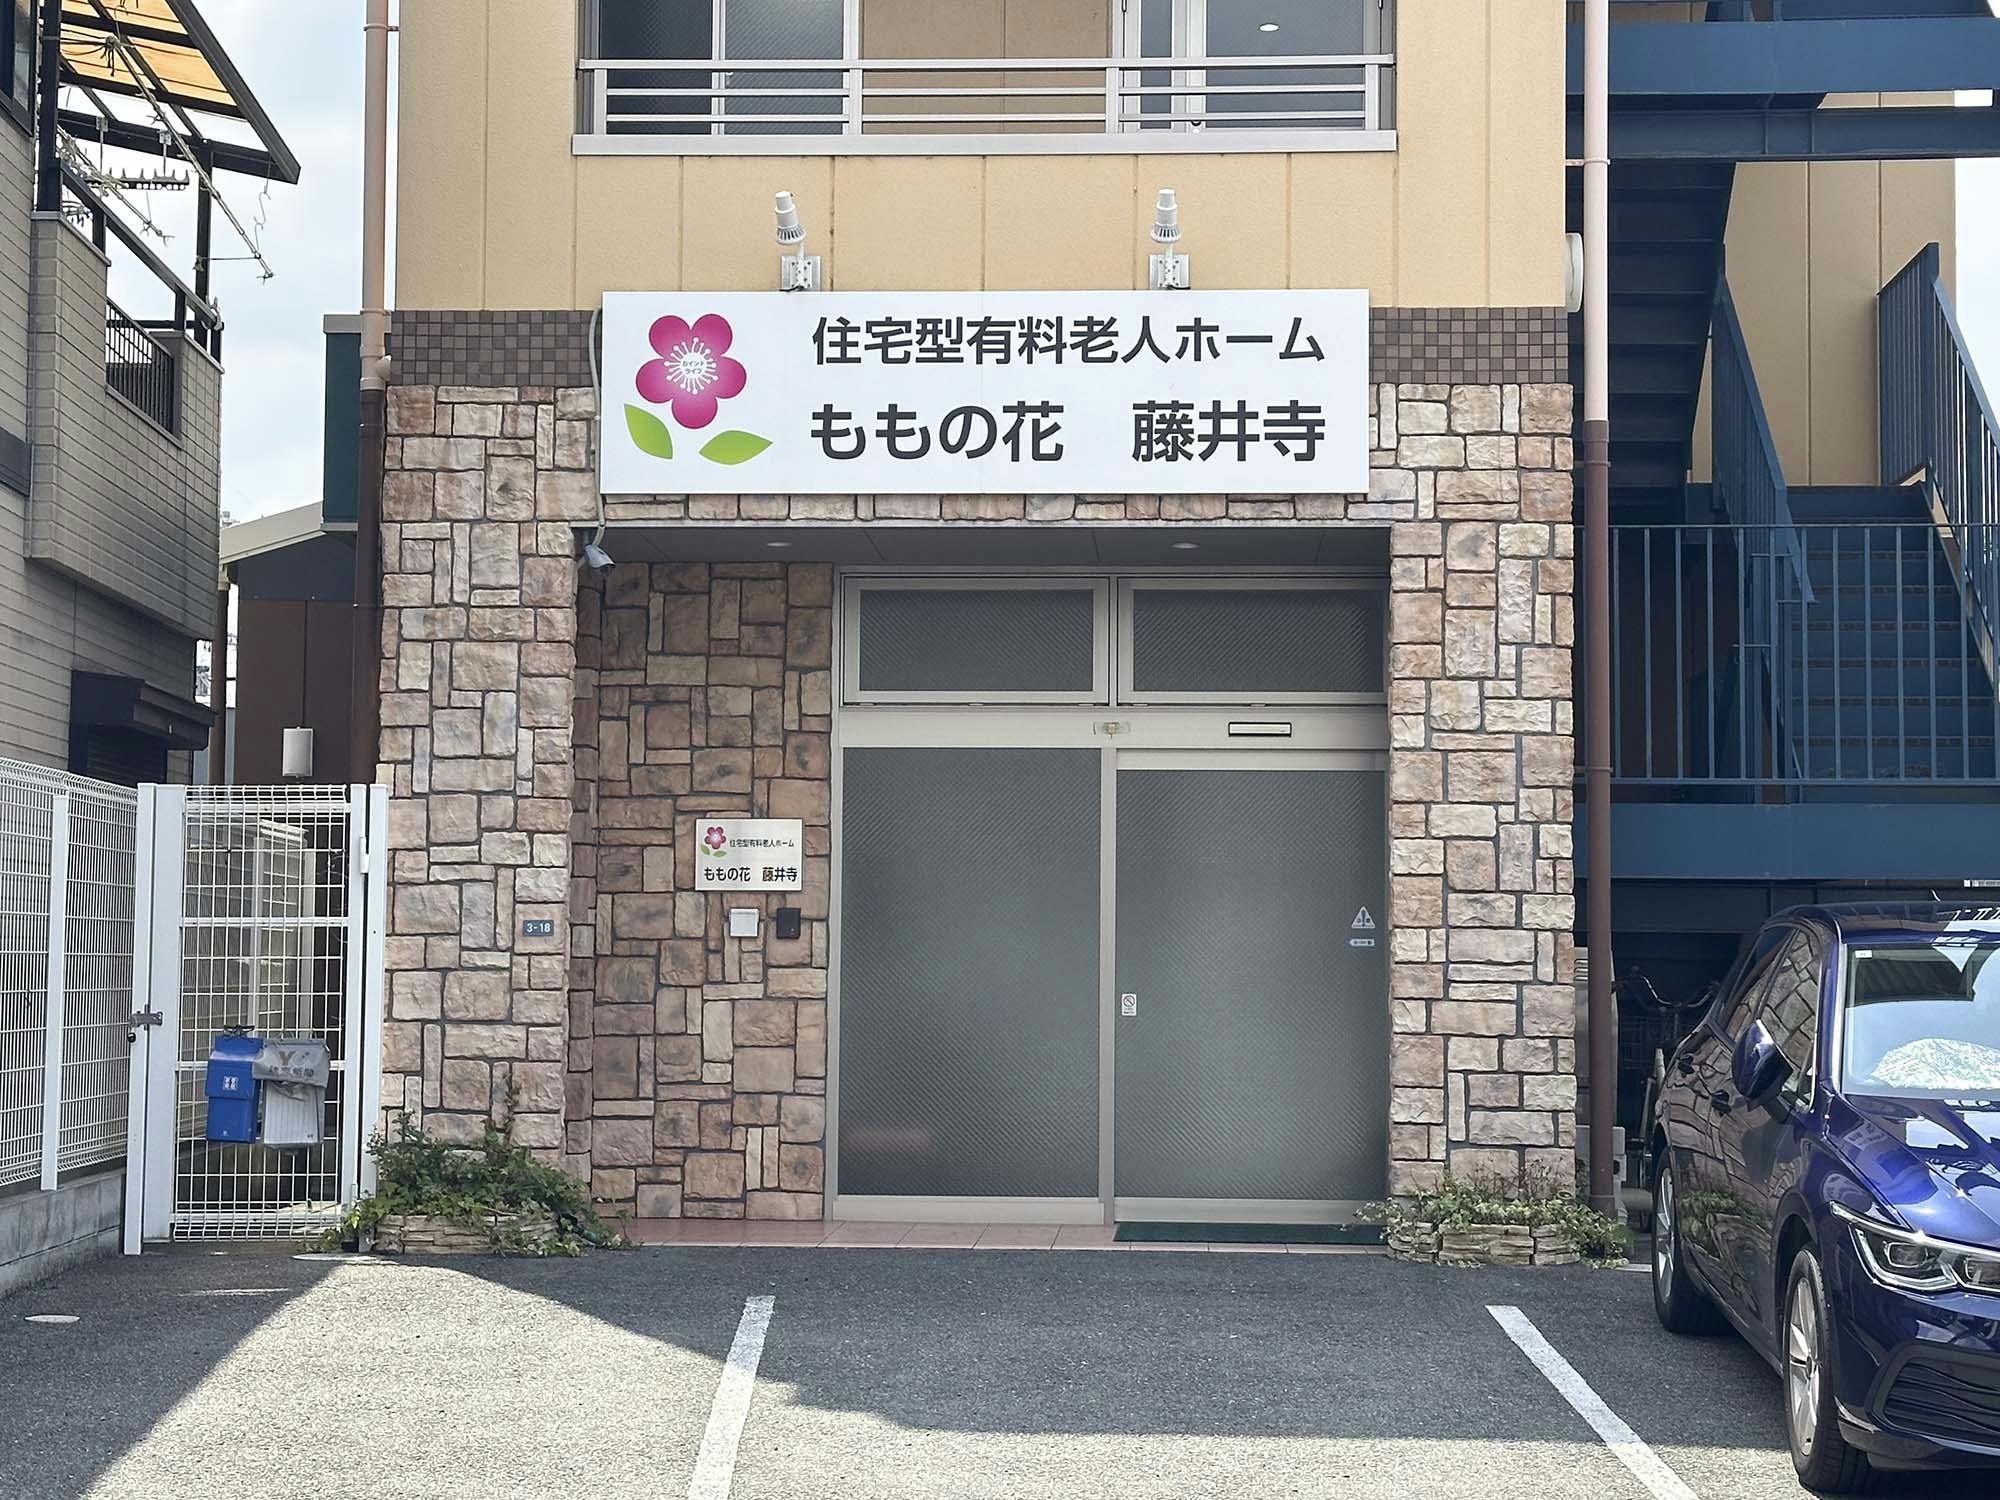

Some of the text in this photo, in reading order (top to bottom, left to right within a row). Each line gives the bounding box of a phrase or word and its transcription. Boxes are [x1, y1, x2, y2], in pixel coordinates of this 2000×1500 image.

[812, 315, 1326, 366] 住宅型有料老人ホーム
[810, 399, 1327, 463] ももの花 藤井寺
[729, 839, 795, 849] 住宅型有料老人ホーム
[703, 866, 798, 882] ももの花 藤井寺
[526, 922, 551, 933] 3-18
